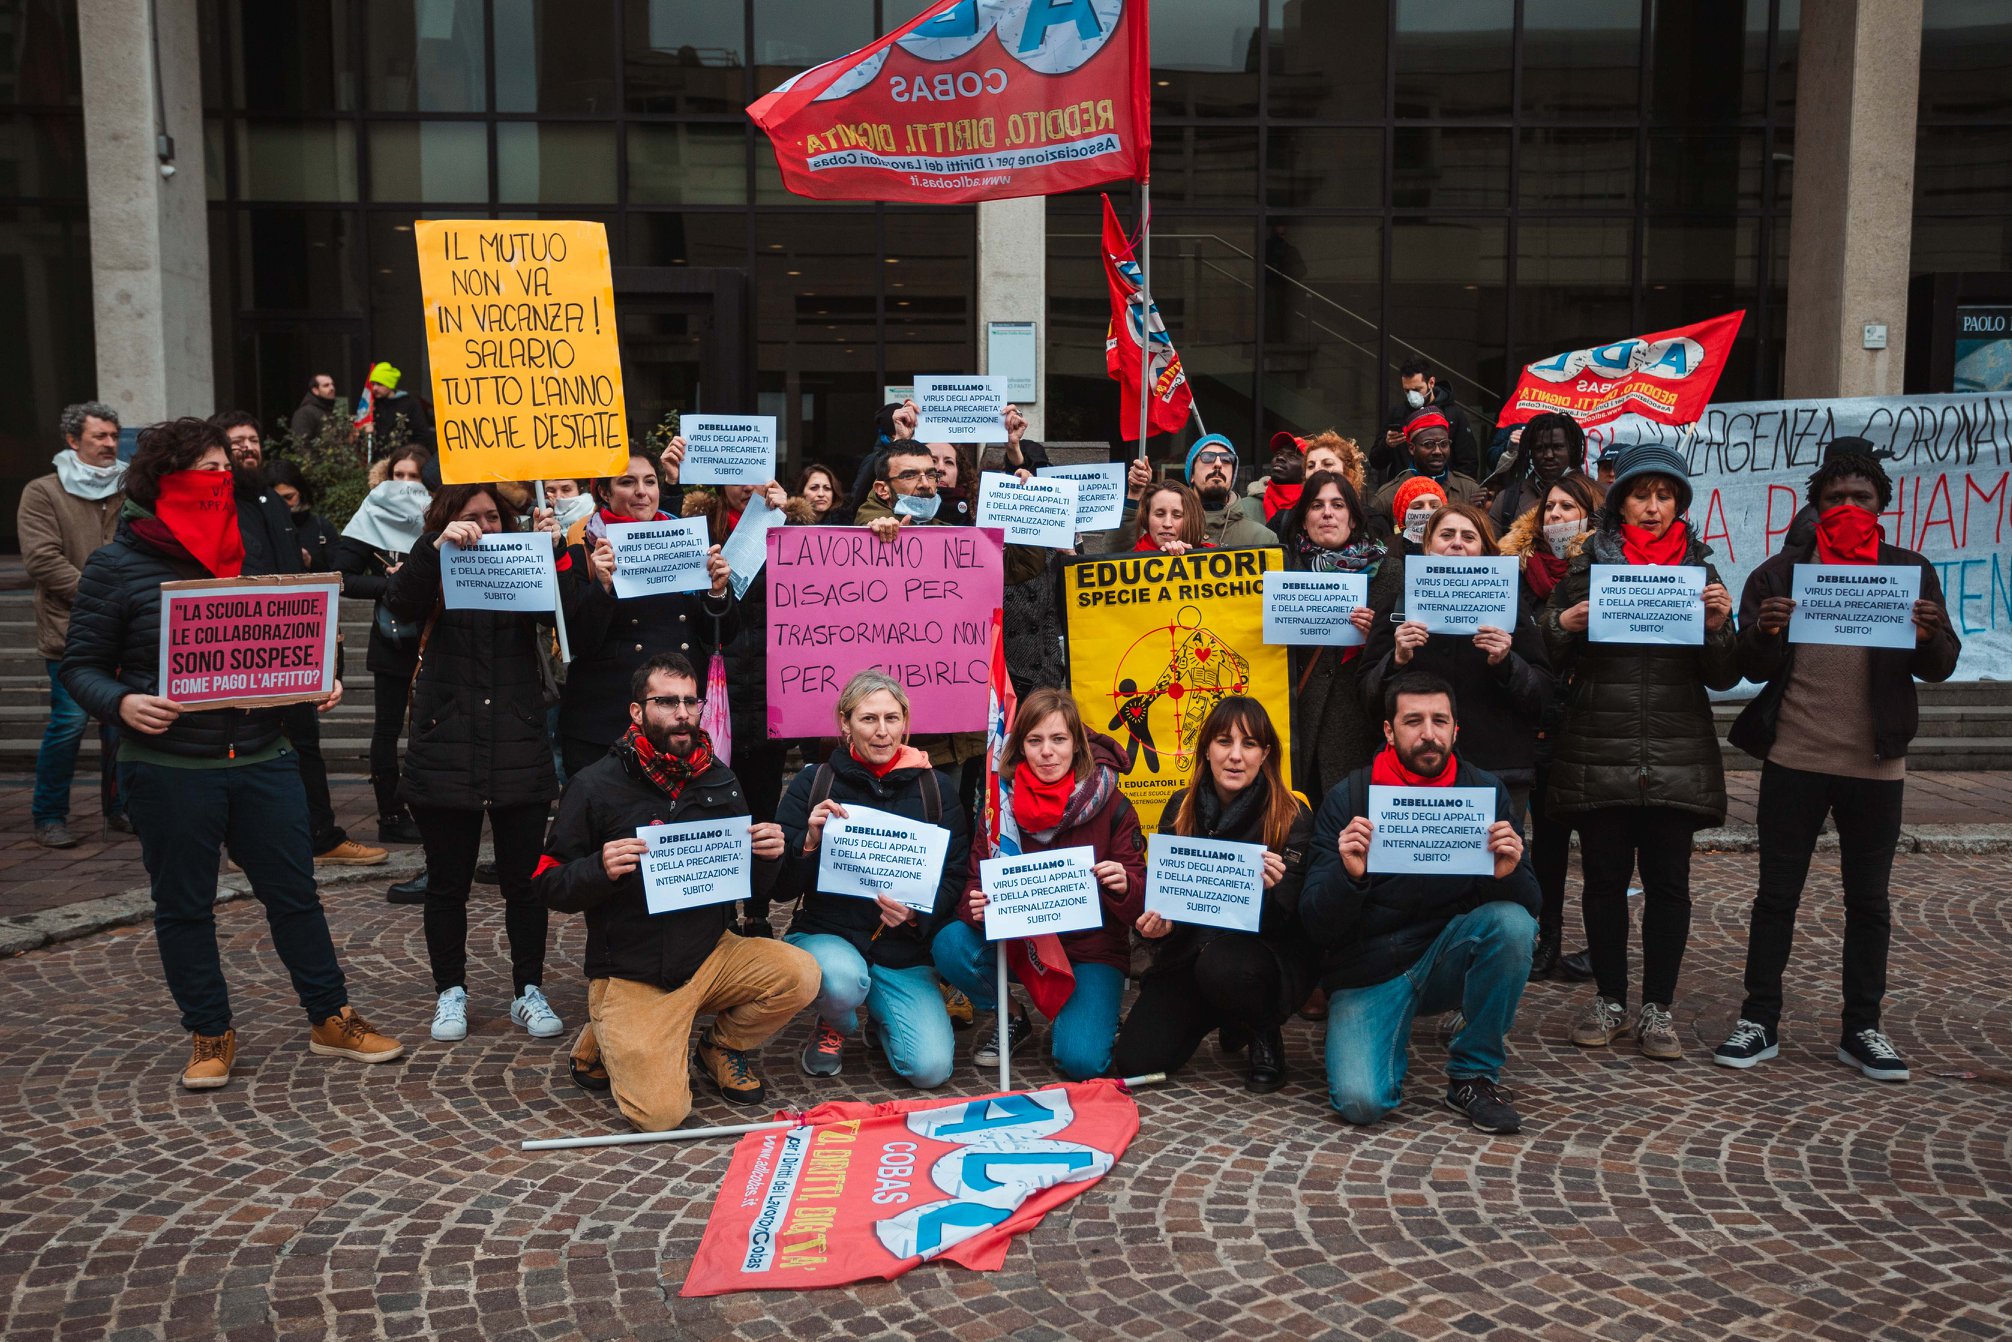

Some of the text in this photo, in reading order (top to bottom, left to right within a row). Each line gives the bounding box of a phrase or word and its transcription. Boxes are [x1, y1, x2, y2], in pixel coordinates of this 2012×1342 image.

[444, 231, 567, 263] IL MUTUO
[452, 267, 553, 297] NON VA
[438, 304, 463, 334] IN
[1963, 316, 2005, 331] PAOLO
[465, 338, 576, 369] SALARIO
[441, 374, 614, 407] TUTTO L'ANNO
[443, 411, 622, 452] ANCHE D'ESTATE
[627, 528, 685, 540] DEBELLIAMO
[618, 538, 703, 553] VIRUS DEGLI APPALTI
[777, 535, 984, 569] LAVORIAMO NEL
[617, 550, 705, 564] E DELLA PRECARIETA'.
[621, 561, 701, 576] INTERNALIZZAZIONE
[1077, 550, 1267, 588] EDUCATORI
[1426, 566, 1500, 575] DEBELLIAMO IL
[647, 574, 677, 585] SUBITO!
[1415, 578, 1509, 587] VIRUS DEGLI APPALTI
[1816, 575, 1899, 585] DEBELLIAMO IL
[775, 578, 963, 608] DISAGIO PER
[1077, 587, 1151, 607] SPECIE
[1157, 586, 1172, 602] A
[1414, 589, 1510, 599] E DELLA PRECARIETA'.
[1804, 587, 1909, 598] VIRUS DEGLI APPALTI
[206, 600, 263, 620] SCUOLA
[266, 598, 323, 618] CHIUDE,
[1417, 603, 1506, 612] INTERNALIZZAZIONE
[1801, 599, 1910, 610] E DELLA PRECARIETA'.
[1444, 615, 1478, 624] SUBITO!
[1805, 612, 1904, 624] INTERNALIZZAZIONE
[172, 622, 320, 646] LE COLLABORAZIONI
[774, 621, 986, 646] TRASFORMARLO NON
[1834, 625, 1872, 635] SUBITO!
[172, 645, 320, 675] SONO SOSPESE,
[172, 676, 210, 695] COME
[212, 674, 247, 692] PAGO
[780, 665, 840, 694] PER
[1124, 780, 1177, 788] EDUCATORI
[1392, 798, 1475, 808] DEBELLIAMO IL
[1380, 811, 1485, 822] VIRUS DEGLI APPALTI
[659, 828, 733, 844] DEBELLIAMO IL
[1378, 824, 1487, 835] E DELLA PRECARIETA'.
[649, 840, 742, 859] VIRUS DEGLI APPALTI
[1383, 839, 1481, 849] INTERNALIZZAZIONE
[649, 852, 743, 873] E DELLA PRECARIETA'.
[1413, 853, 1450, 862] SUBITO!
[656, 866, 739, 886] INTERNALIZZAZIONE
[1002, 858, 1075, 876] DEBELLIAMO IL
[993, 869, 1086, 890] VIRUS DEGLI APPALTI
[682, 883, 714, 896] SUBITO!
[992, 882, 1090, 903] E DELLA PRECARIETA'.
[998, 896, 1087, 915] INTERNALIZZAZIONE
[1027, 912, 1061, 924] SUBITO!
[785, 1134, 802, 1152] per
[741, 1135, 777, 1208] www.adlcobas.it
[776, 1156, 799, 1179] Diritti
[796, 1149, 852, 1202] DIRITTI,
[871, 1140, 918, 1206] COBAS
[771, 1180, 790, 1194] dei
[747, 1230, 770, 1269] Cobas
